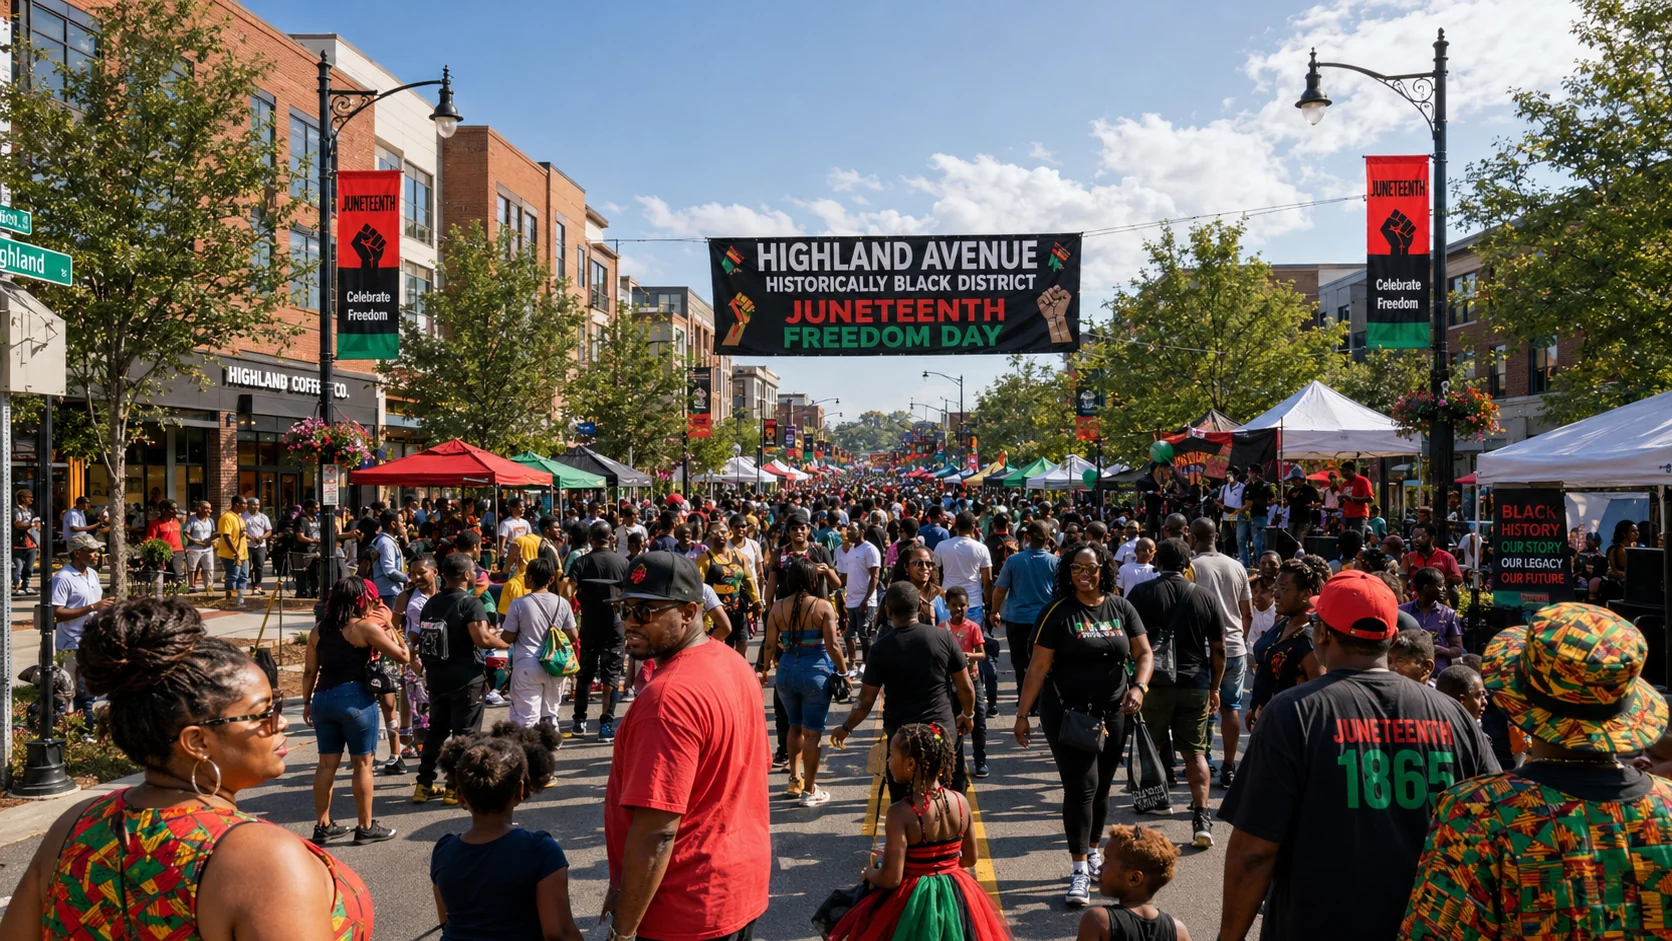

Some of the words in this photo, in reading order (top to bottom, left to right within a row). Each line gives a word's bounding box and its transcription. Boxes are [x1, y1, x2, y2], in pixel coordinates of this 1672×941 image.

[1370, 180, 1426, 197] JUNETEENTH
[342, 195, 396, 212] JUNETEENTH
[757, 241, 913, 272] HIGHLAND
[921, 240, 1038, 270] AVENUE
[766, 275, 888, 292] HISTORICALLY
[894, 275, 952, 292] BLACK
[958, 274, 1037, 291] DISTRICT
[1376, 278, 1422, 291] Celebrate
[347, 290, 391, 303] Celebrate
[1377, 296, 1419, 309] Freedom
[348, 308, 388, 321] Freedom
[785, 297, 1005, 324] JUNETEENTH
[784, 325, 931, 348] FREEDOM
[941, 324, 1004, 347] DAY
[228, 365, 288, 390] HIGHLAND
[292, 375, 321, 394] COFFE
[334, 382, 350, 399] CO.
[1502, 504, 1557, 519] BLACK
[1502, 523, 1561, 537] HISTORY
[1501, 541, 1524, 553] OUR
[1526, 541, 1562, 554] STORY
[1501, 557, 1522, 568] OUR
[1524, 557, 1563, 569] LEGACY
[1501, 572, 1523, 584] OUR
[1525, 572, 1565, 584] FUTURE
[1333, 718, 1453, 746] JUNETEENTH
[1337, 749, 1455, 810] 1865
